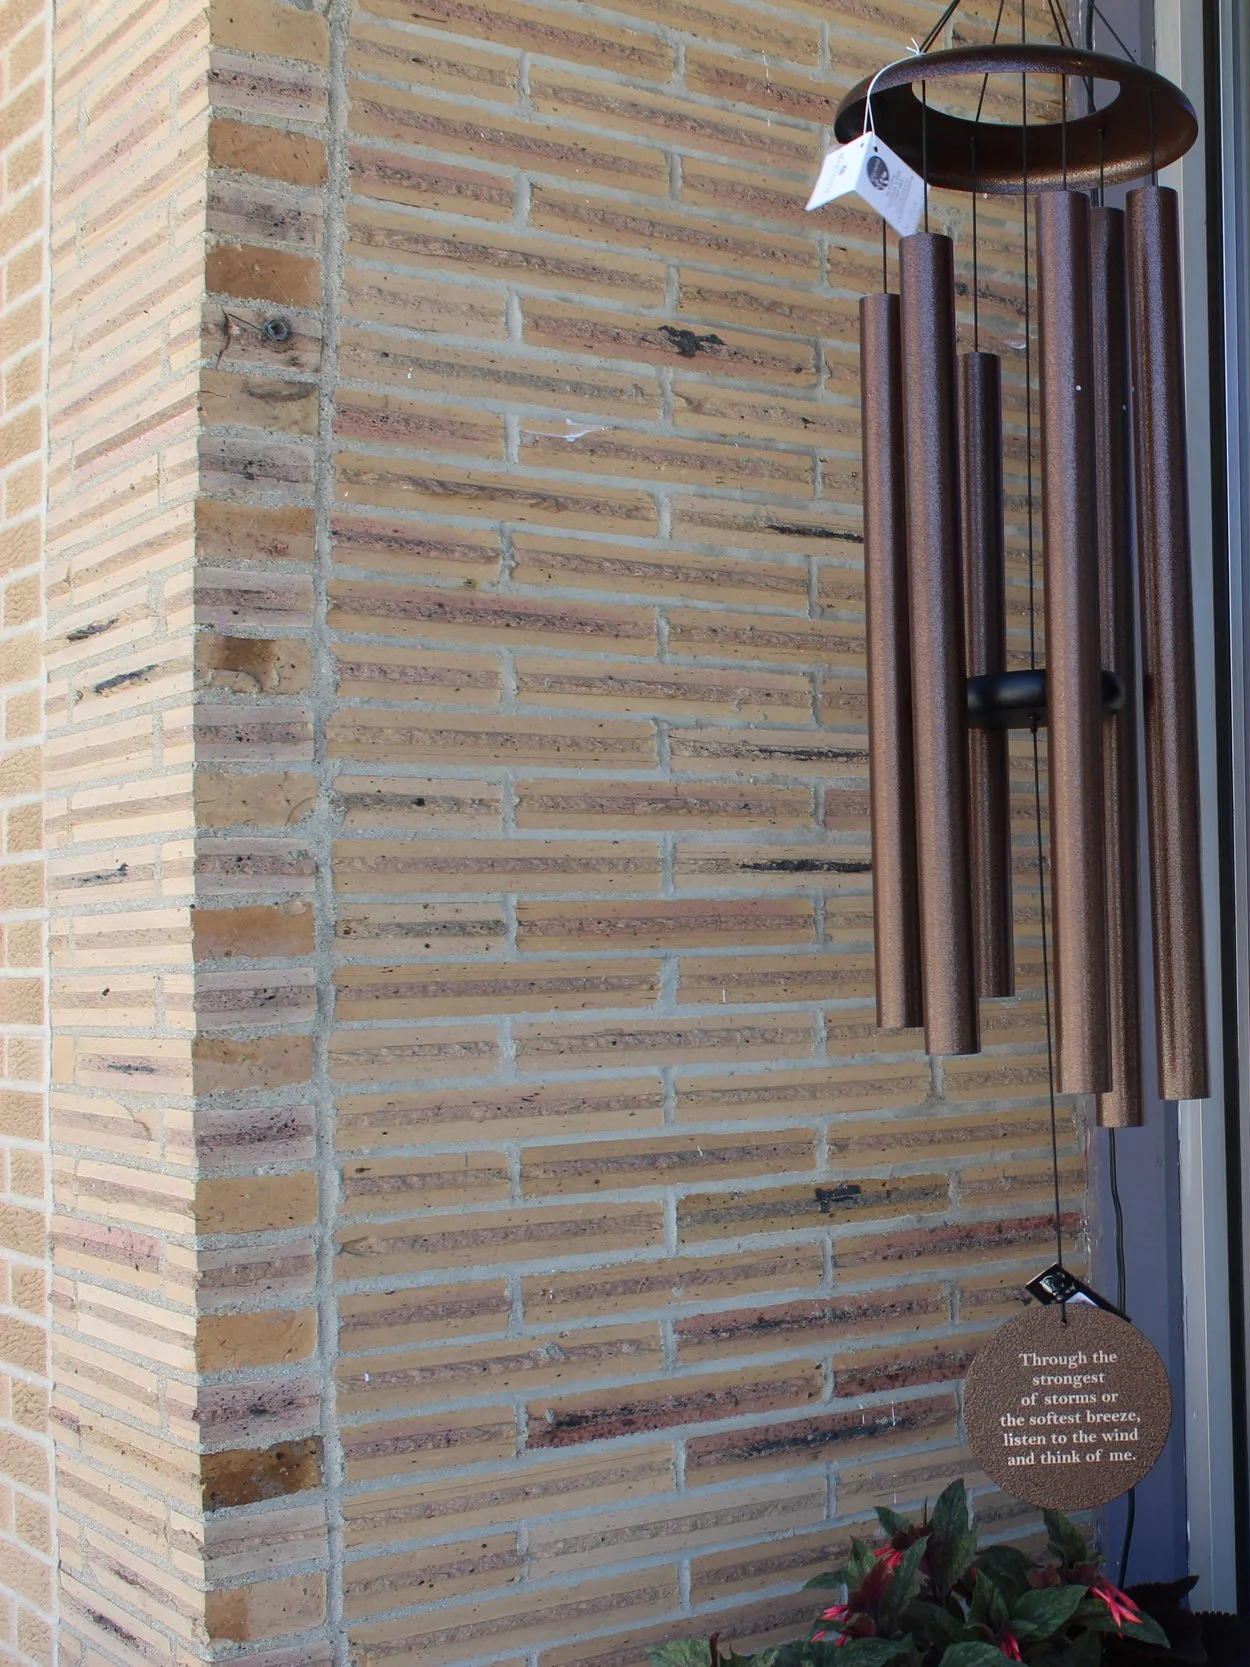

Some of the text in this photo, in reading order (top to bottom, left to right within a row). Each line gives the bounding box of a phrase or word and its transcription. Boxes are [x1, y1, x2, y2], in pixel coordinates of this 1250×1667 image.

[1019, 1350, 1118, 1369] Through the
[1032, 1372, 1106, 1389] strongest
[1021, 1392, 1119, 1406] of storms or
[1000, 1409, 1141, 1427] the softest breeze,
[1003, 1427, 1139, 1447] listen to the wind
[1007, 1449, 1136, 1466] and think of me.
